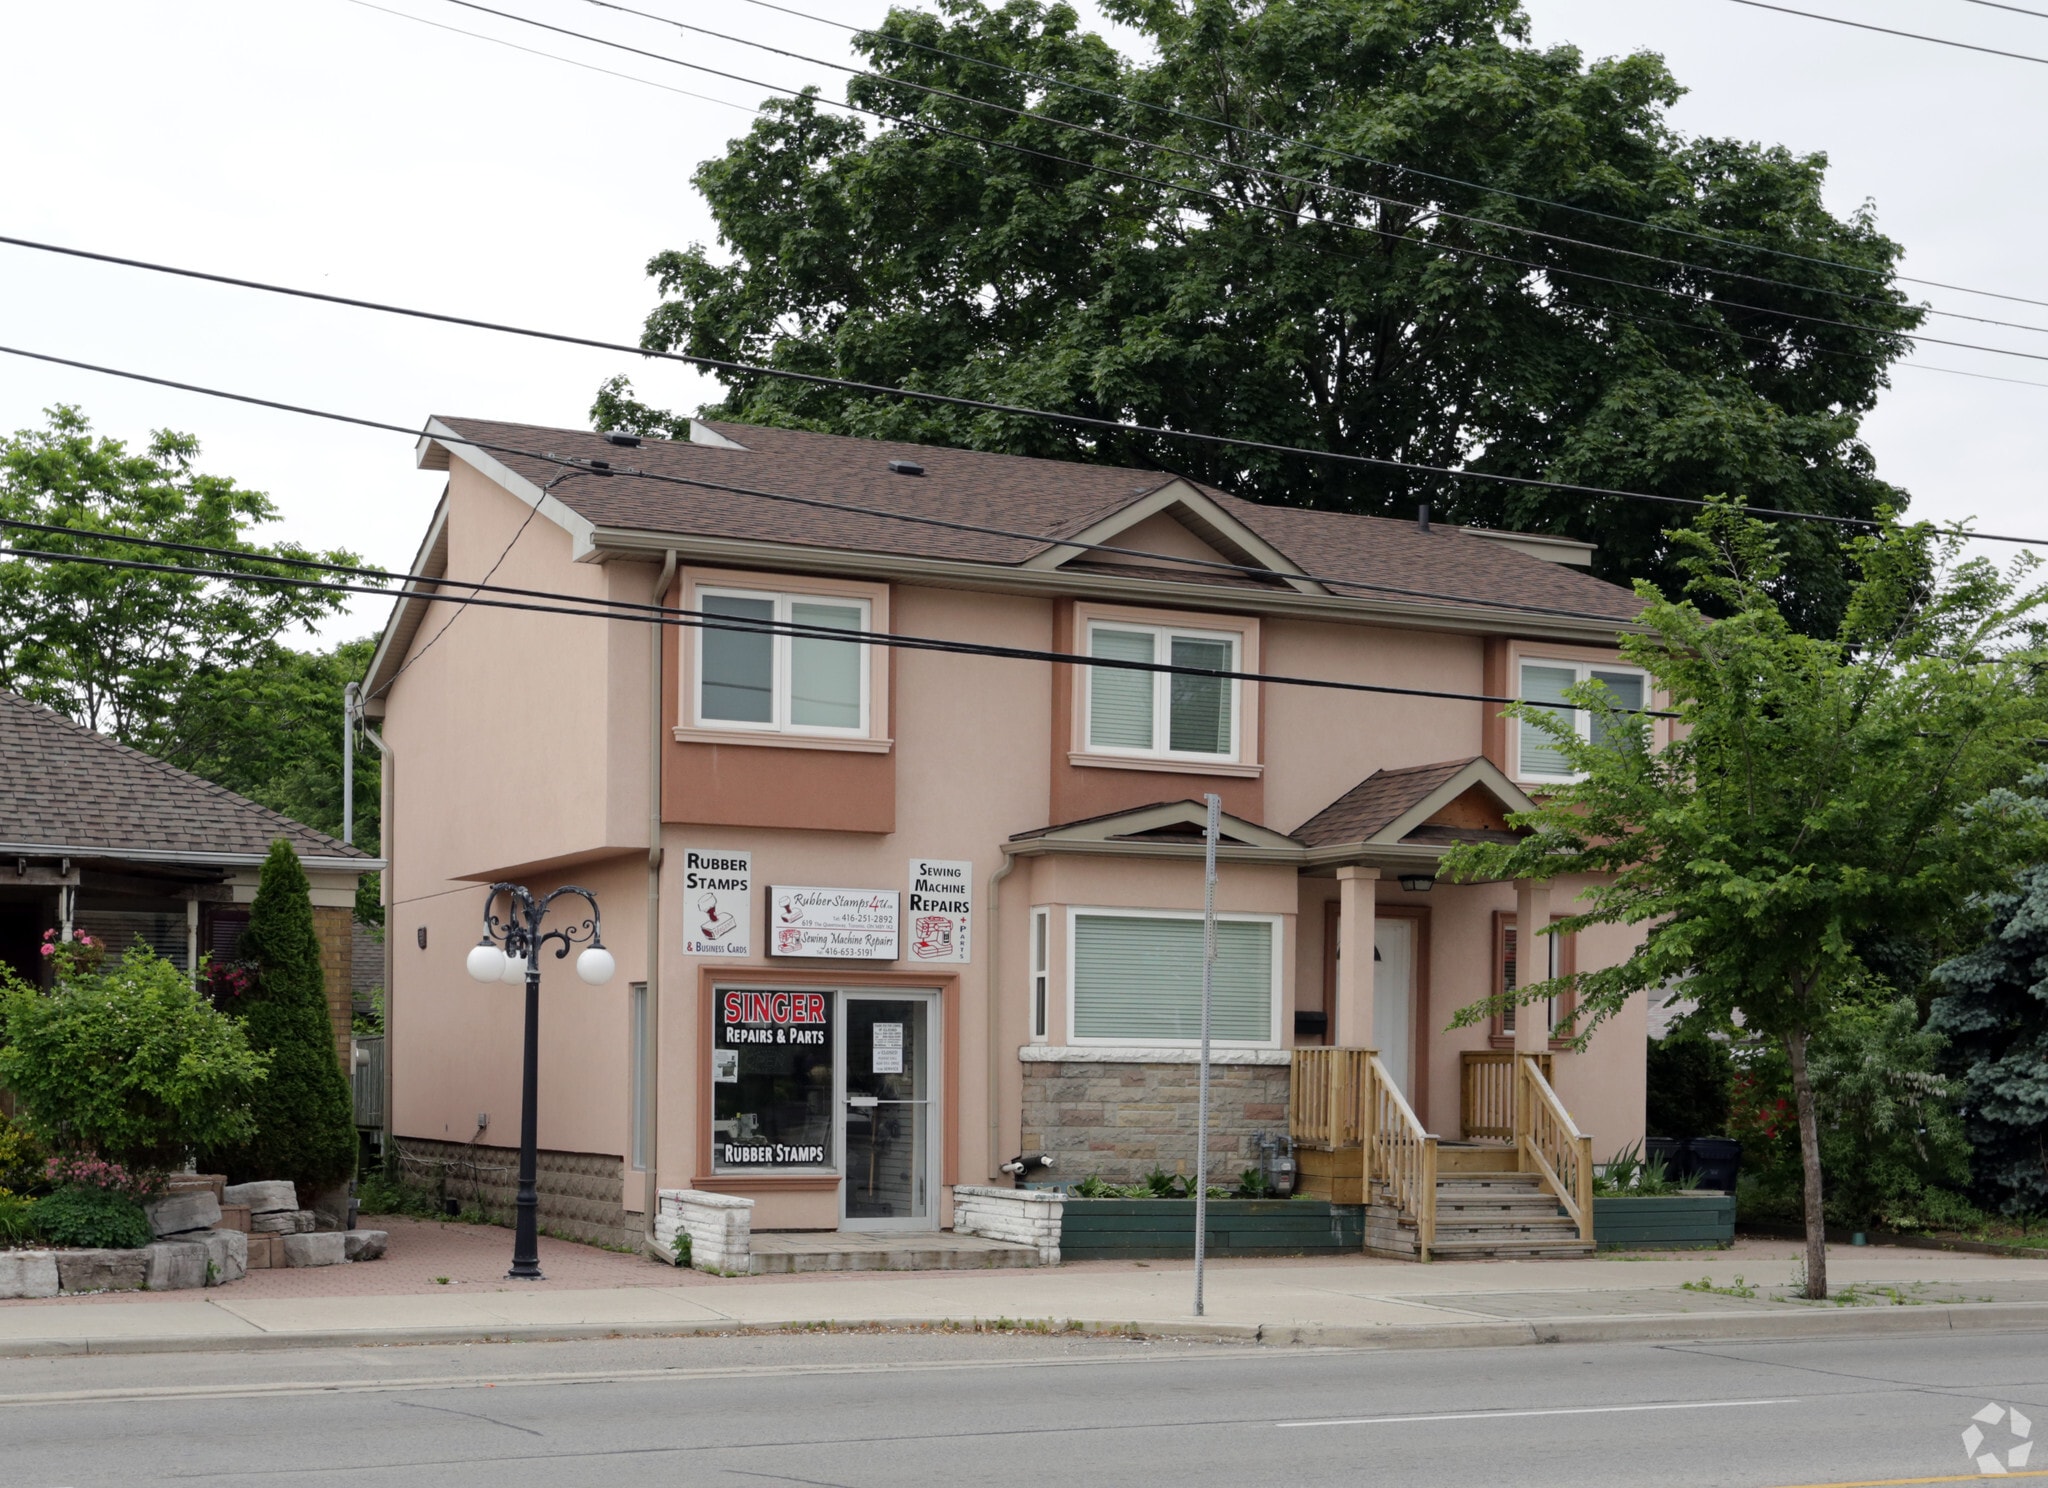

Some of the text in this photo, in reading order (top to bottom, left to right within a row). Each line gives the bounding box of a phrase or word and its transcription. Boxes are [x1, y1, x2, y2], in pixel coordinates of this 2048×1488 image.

[687, 853, 748, 871] RUBBER
[919, 863, 961, 878] SEWING
[686, 873, 748, 891] STAMPS
[914, 879, 966, 894] MACHINE
[910, 893, 970, 914] REPAIRS
[801, 919, 813, 927] 619
[841, 913, 894, 924] 416-251-2892
[686, 941, 747, 954] & BUSINESS CARDS
[801, 931, 894, 951] Sewing Machine Repairs
[959, 925, 967, 960] PARTS
[824, 947, 874, 957] 416-653-5191
[724, 991, 827, 1024] SINGER
[726, 1026, 825, 1045] REPAIRS & PARTS
[725, 1143, 825, 1163] RUBBER STAMPS
